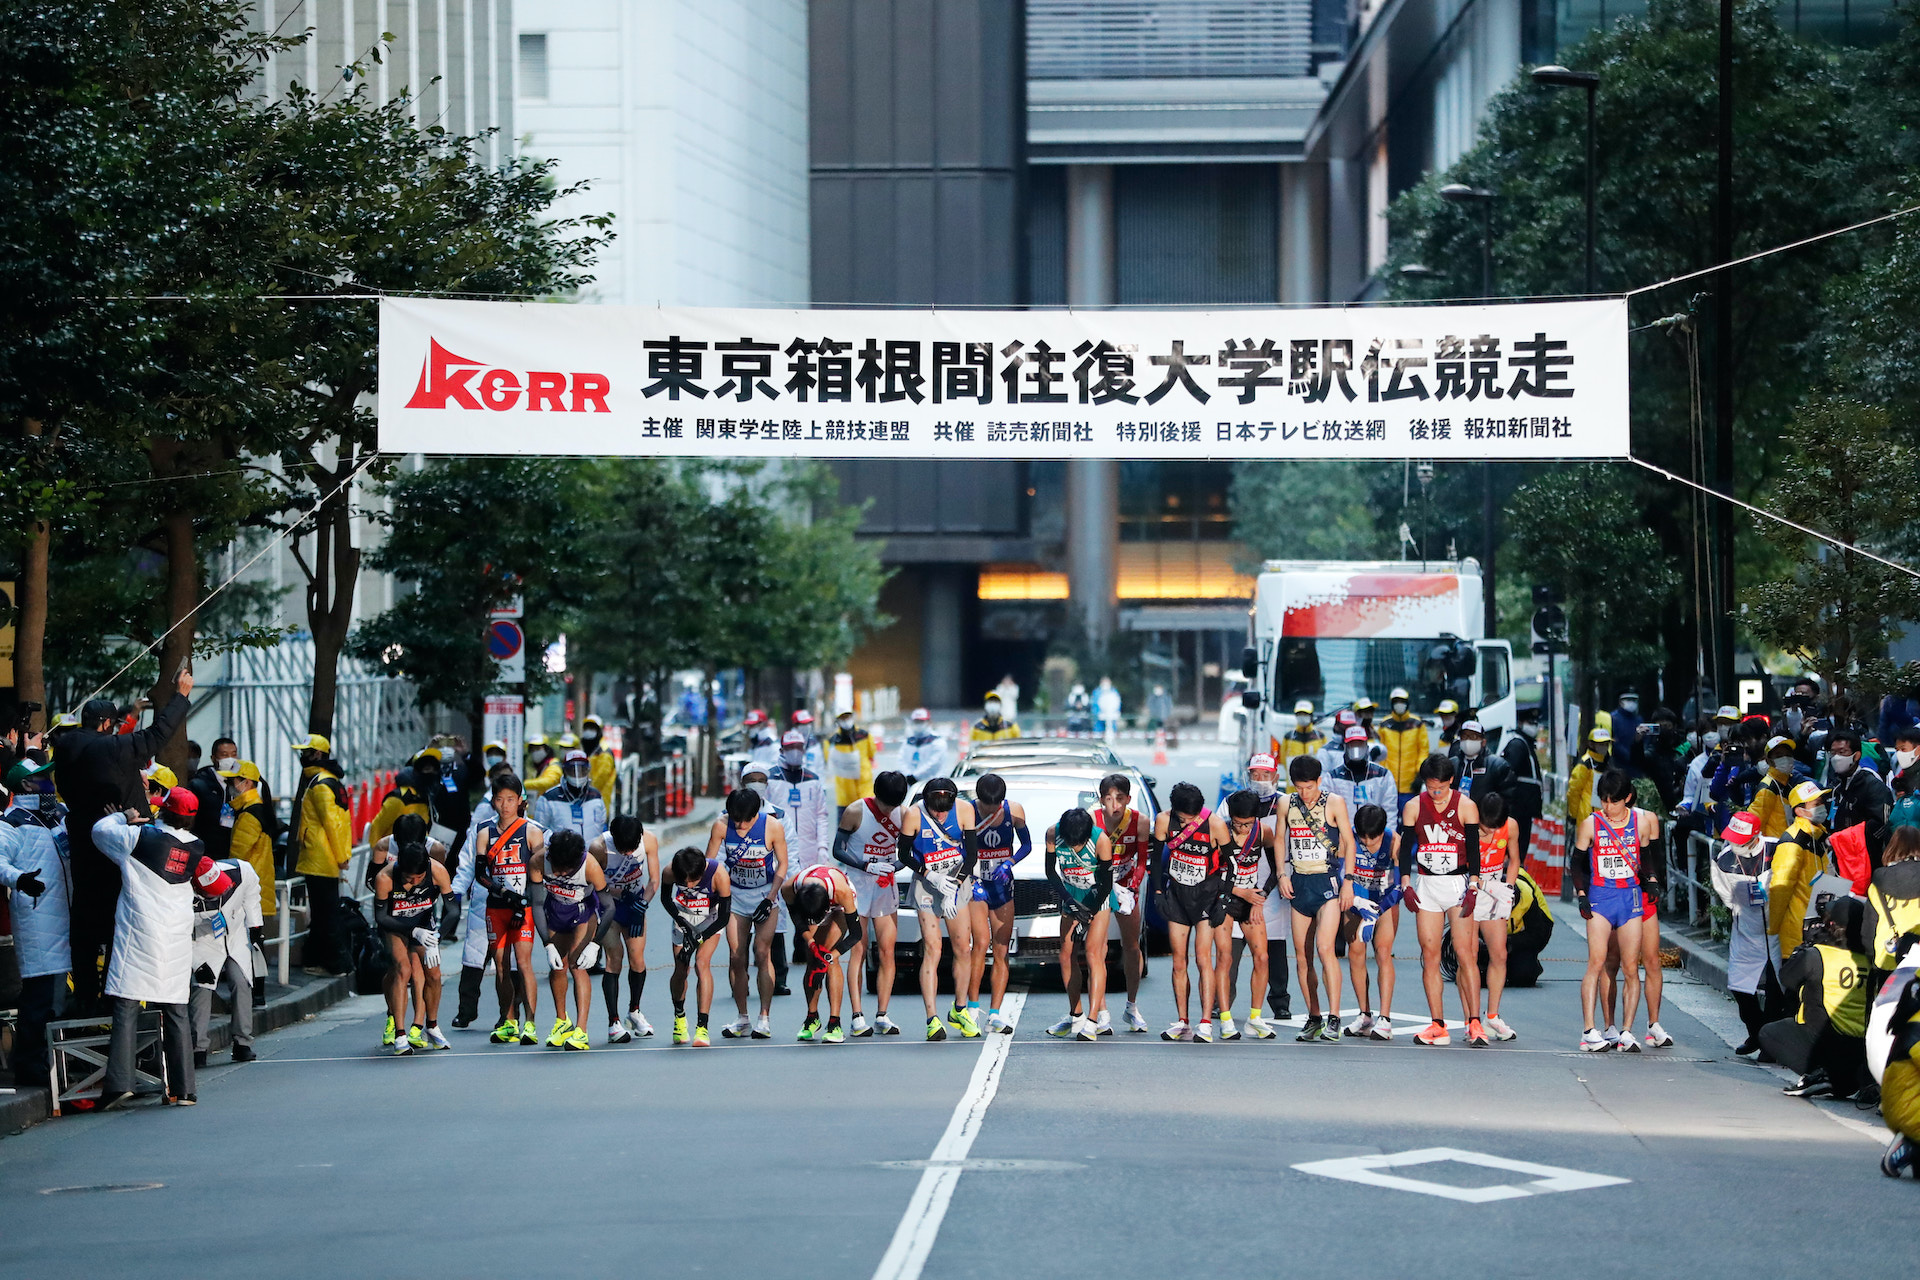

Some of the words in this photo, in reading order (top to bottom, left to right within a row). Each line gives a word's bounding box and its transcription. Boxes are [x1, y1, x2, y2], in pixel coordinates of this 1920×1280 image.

[641, 332, 1575, 406] 東京箱根間往復大学駅伝競走
[642, 417, 684, 438] 主催
[696, 418, 910, 441] 関東学生陸上競技連盟
[934, 420, 975, 442] 共催
[987, 421, 1094, 442] 読売新聞社
[1116, 420, 1202, 442] 特別後援
[1216, 419, 1386, 442] 日本テレビ放送網
[1409, 418, 1452, 440] 後援
[1464, 417, 1573, 440] 報知新聞社
[1739, 679, 1763, 714] P
[1423, 823, 1449, 844] W
[1294, 838, 1321, 850] 東国大
[982, 850, 1010, 858] SAPPORO
[1178, 853, 1206, 864] SAPPORO
[1297, 850, 1320, 860] 5-15
[1424, 853, 1451, 865] 早大
[499, 866, 526, 875] SAPPORO
[732, 866, 765, 879] 神奈川大
[1170, 857, 1204, 878] 國學院大
[1609, 868, 1629, 878] 9-1
